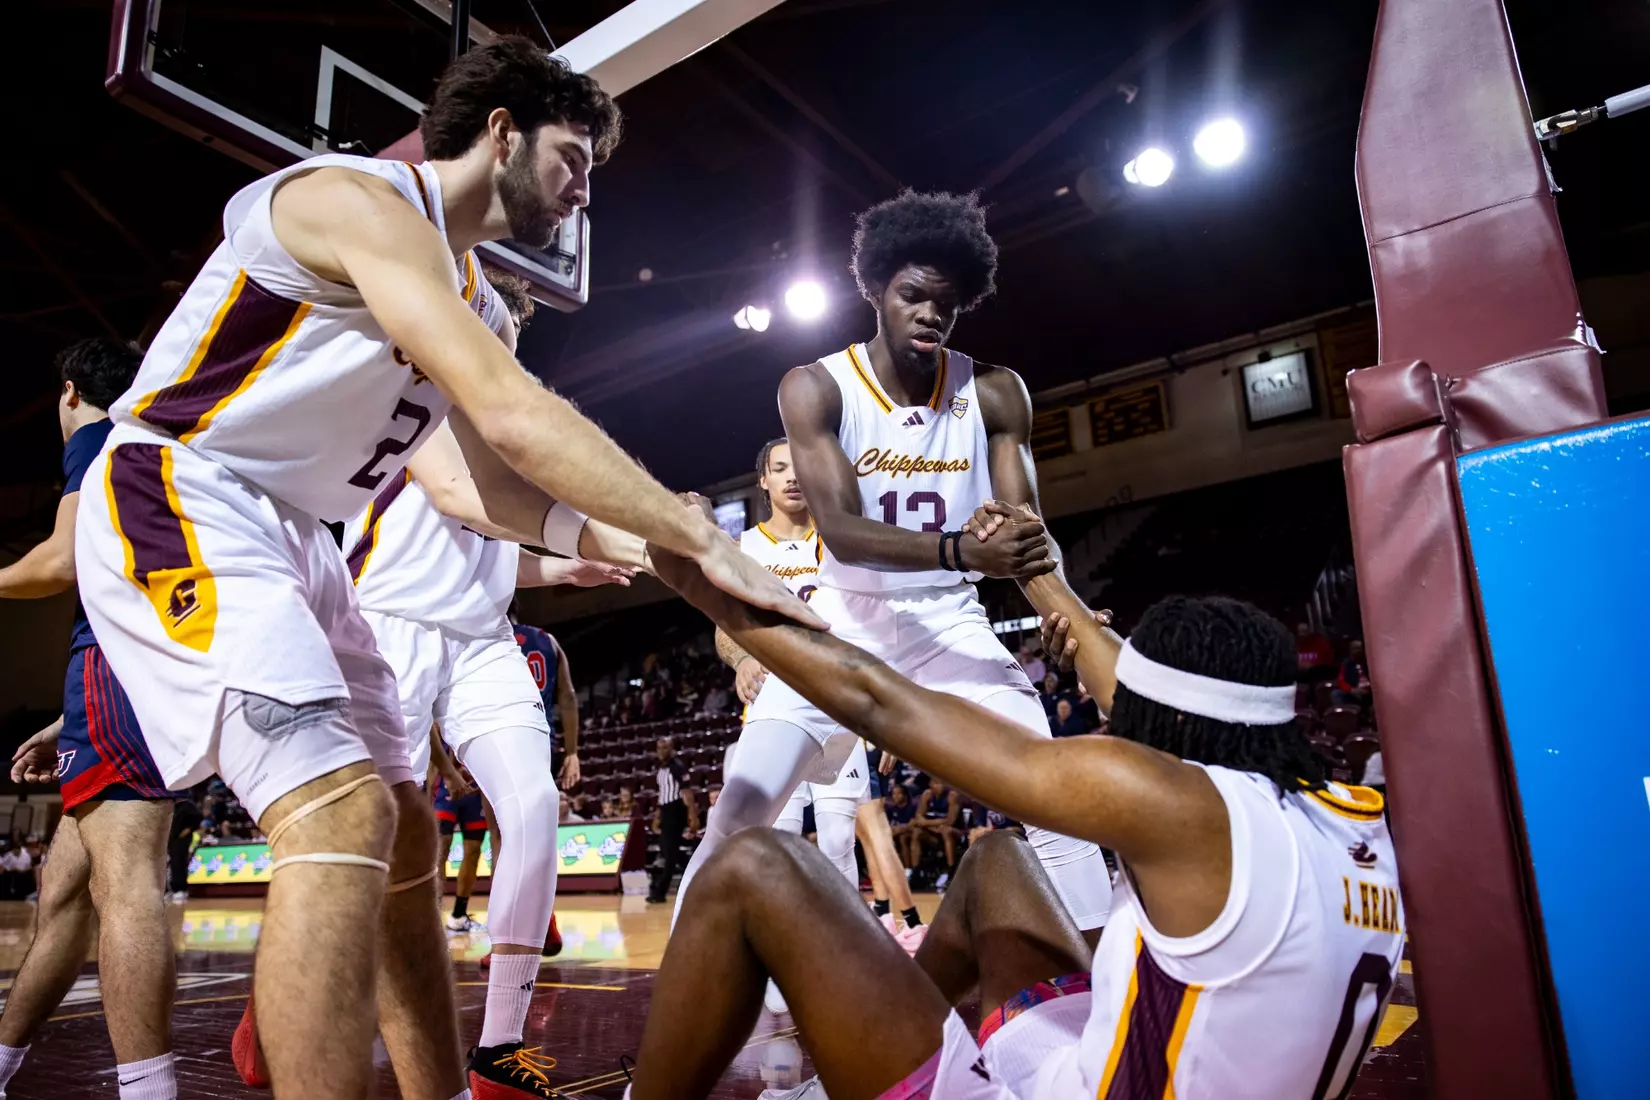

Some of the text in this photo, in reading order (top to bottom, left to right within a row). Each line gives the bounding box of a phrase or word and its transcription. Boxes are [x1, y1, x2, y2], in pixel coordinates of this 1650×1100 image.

[347, 396, 432, 491] 2
[853, 447, 971, 479] Chippewas
[878, 490, 947, 533] 13
